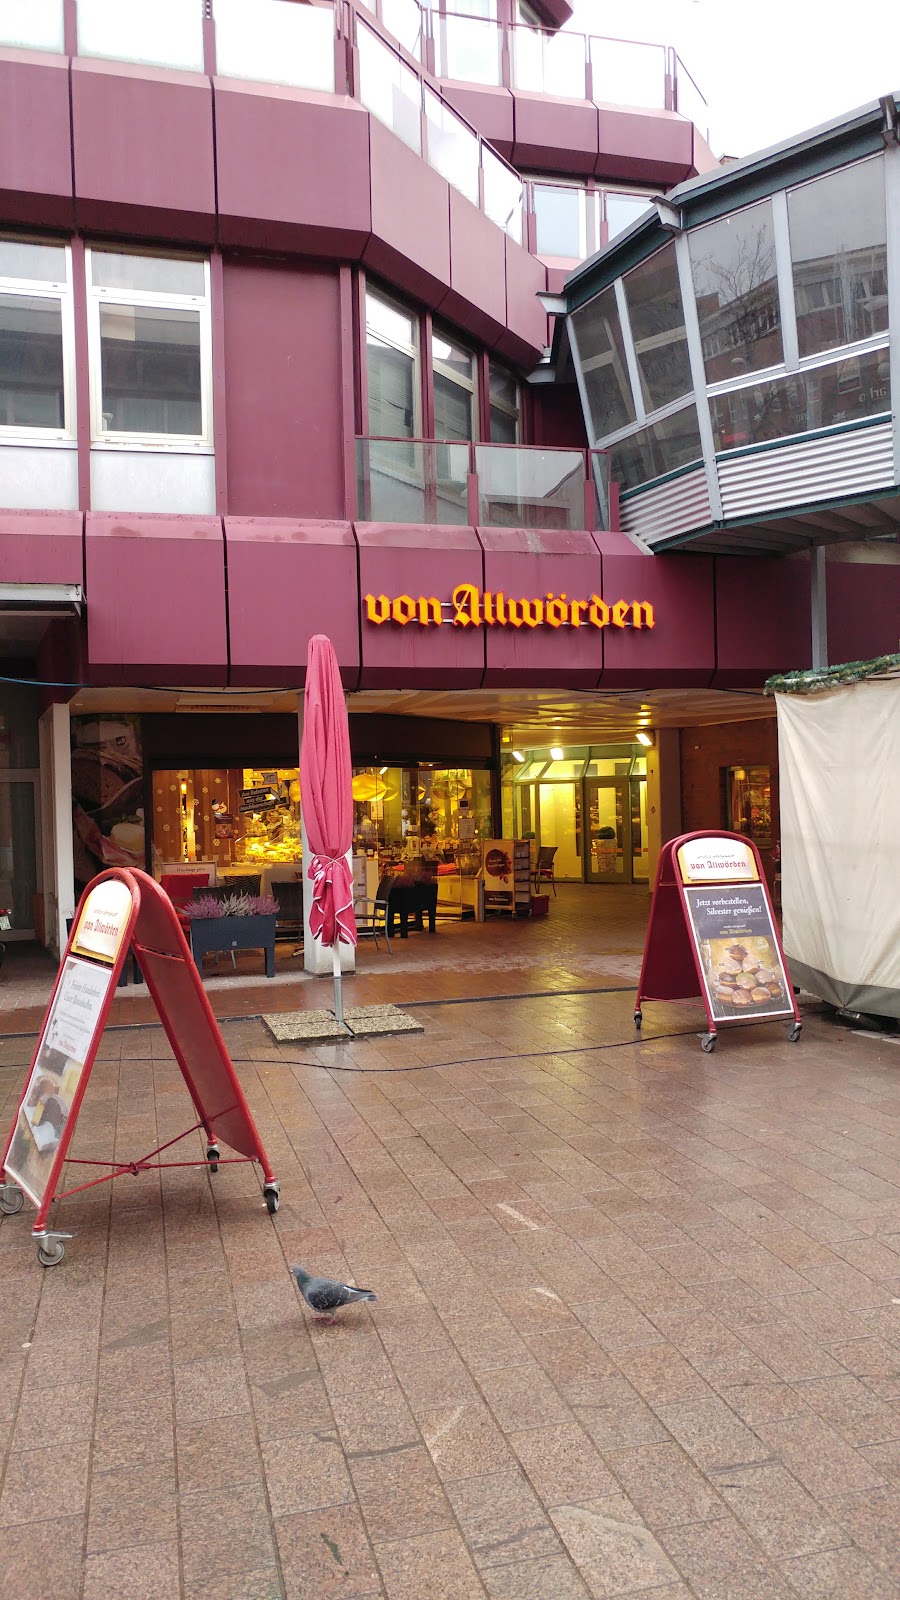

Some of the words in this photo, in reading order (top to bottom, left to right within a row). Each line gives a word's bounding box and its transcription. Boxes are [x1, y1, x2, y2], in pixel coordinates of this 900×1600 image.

[364, 593, 443, 626] von
[452, 583, 656, 629] Allwörden
[707, 860, 746, 869] Allwörden
[696, 899, 711, 908] Jetzt
[712, 897, 749, 905] vorbestellen,
[706, 907, 732, 915] Silvester
[733, 906, 762, 916] genießen!
